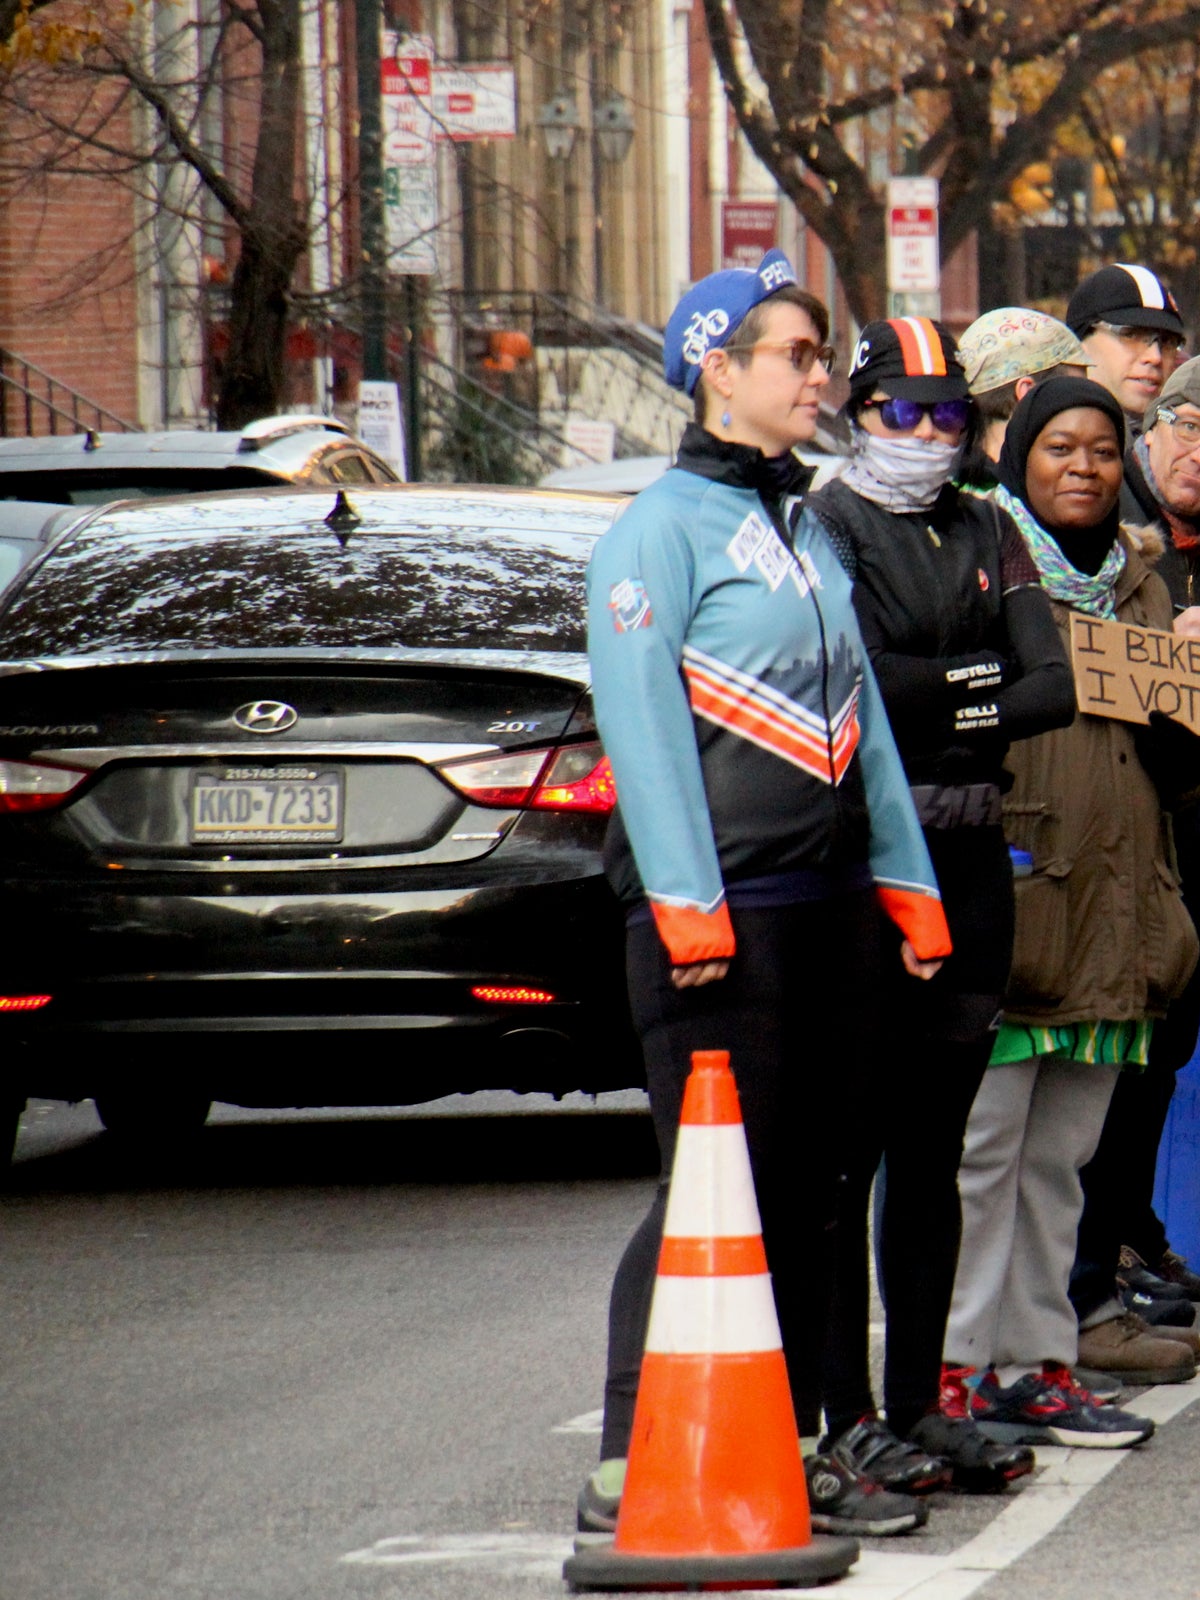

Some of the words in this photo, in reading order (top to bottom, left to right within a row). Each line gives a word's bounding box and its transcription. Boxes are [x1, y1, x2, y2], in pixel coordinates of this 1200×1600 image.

[1076, 618, 1103, 655] I
[1086, 667, 1116, 705] I
[0, 725, 99, 735] SONATA
